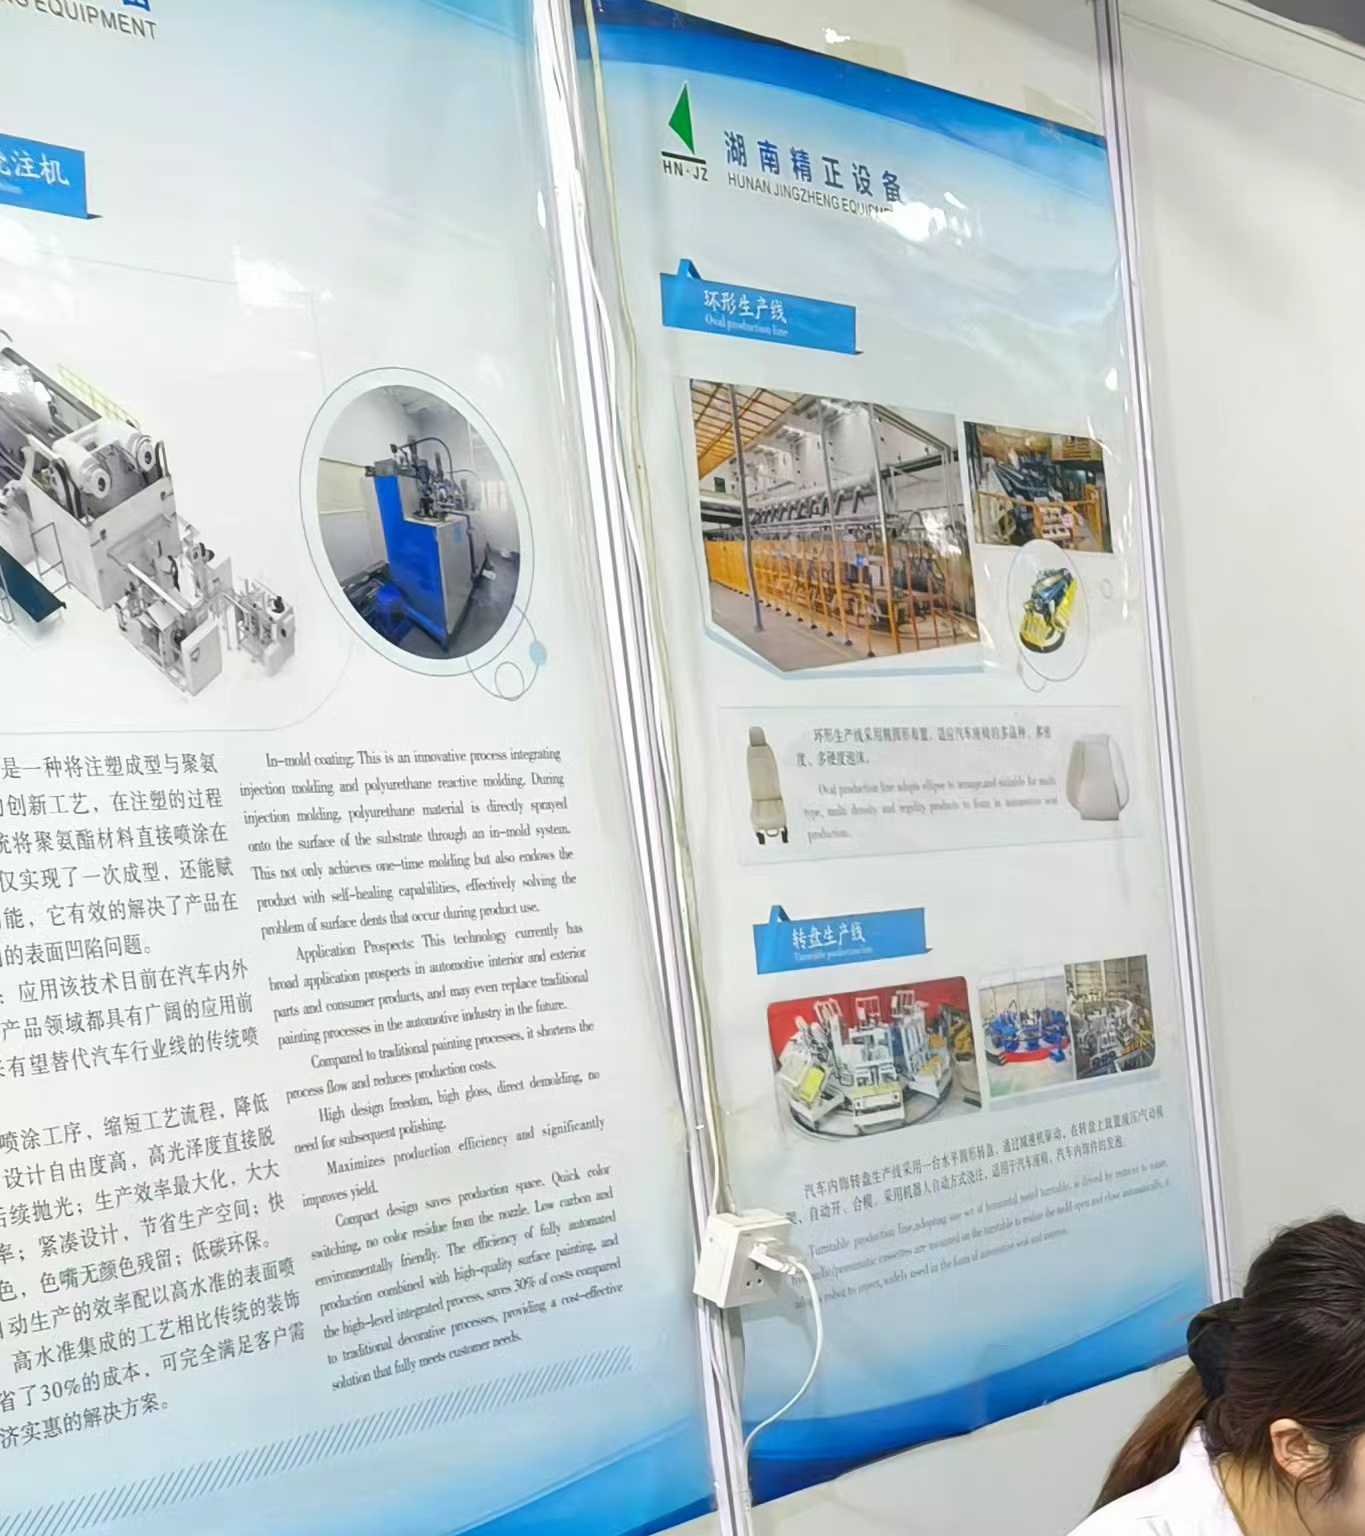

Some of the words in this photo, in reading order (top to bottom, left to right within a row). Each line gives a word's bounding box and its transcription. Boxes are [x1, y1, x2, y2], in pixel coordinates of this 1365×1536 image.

[724, 131, 901, 202] 湖南精正设备
[728, 172, 771, 194] HUNAN
[774, 183, 840, 210] JINGZHENG
[704, 289, 787, 323] 环形生产线
[239, 780, 285, 800] injection
[291, 778, 335, 797] molding
[339, 776, 359, 792] and
[364, 775, 432, 795] polyurethane
[437, 774, 477, 788] reactive
[530, 771, 564, 787] During
[249, 865, 276, 880] This
[279, 866, 297, 878] not
[300, 861, 323, 877] only
[328, 859, 372, 875] achieves
[375, 856, 424, 871] one-time
[427, 852, 470, 870] molding
[472, 850, 490, 865] but
[494, 849, 515, 864] also
[518, 847, 555, 862] endows
[558, 845, 573, 860] the
[792, 921, 866, 949] 转盘生产线
[267, 973, 299, 991] broad
[303, 968, 360, 990] application
[363, 965, 411, 984] prospects
[414, 960, 425, 974] in
[429, 955, 484, 973] automotive
[487, 951, 524, 967] interior
[527, 947, 546, 963] and
[549, 945, 586, 960] exterior
